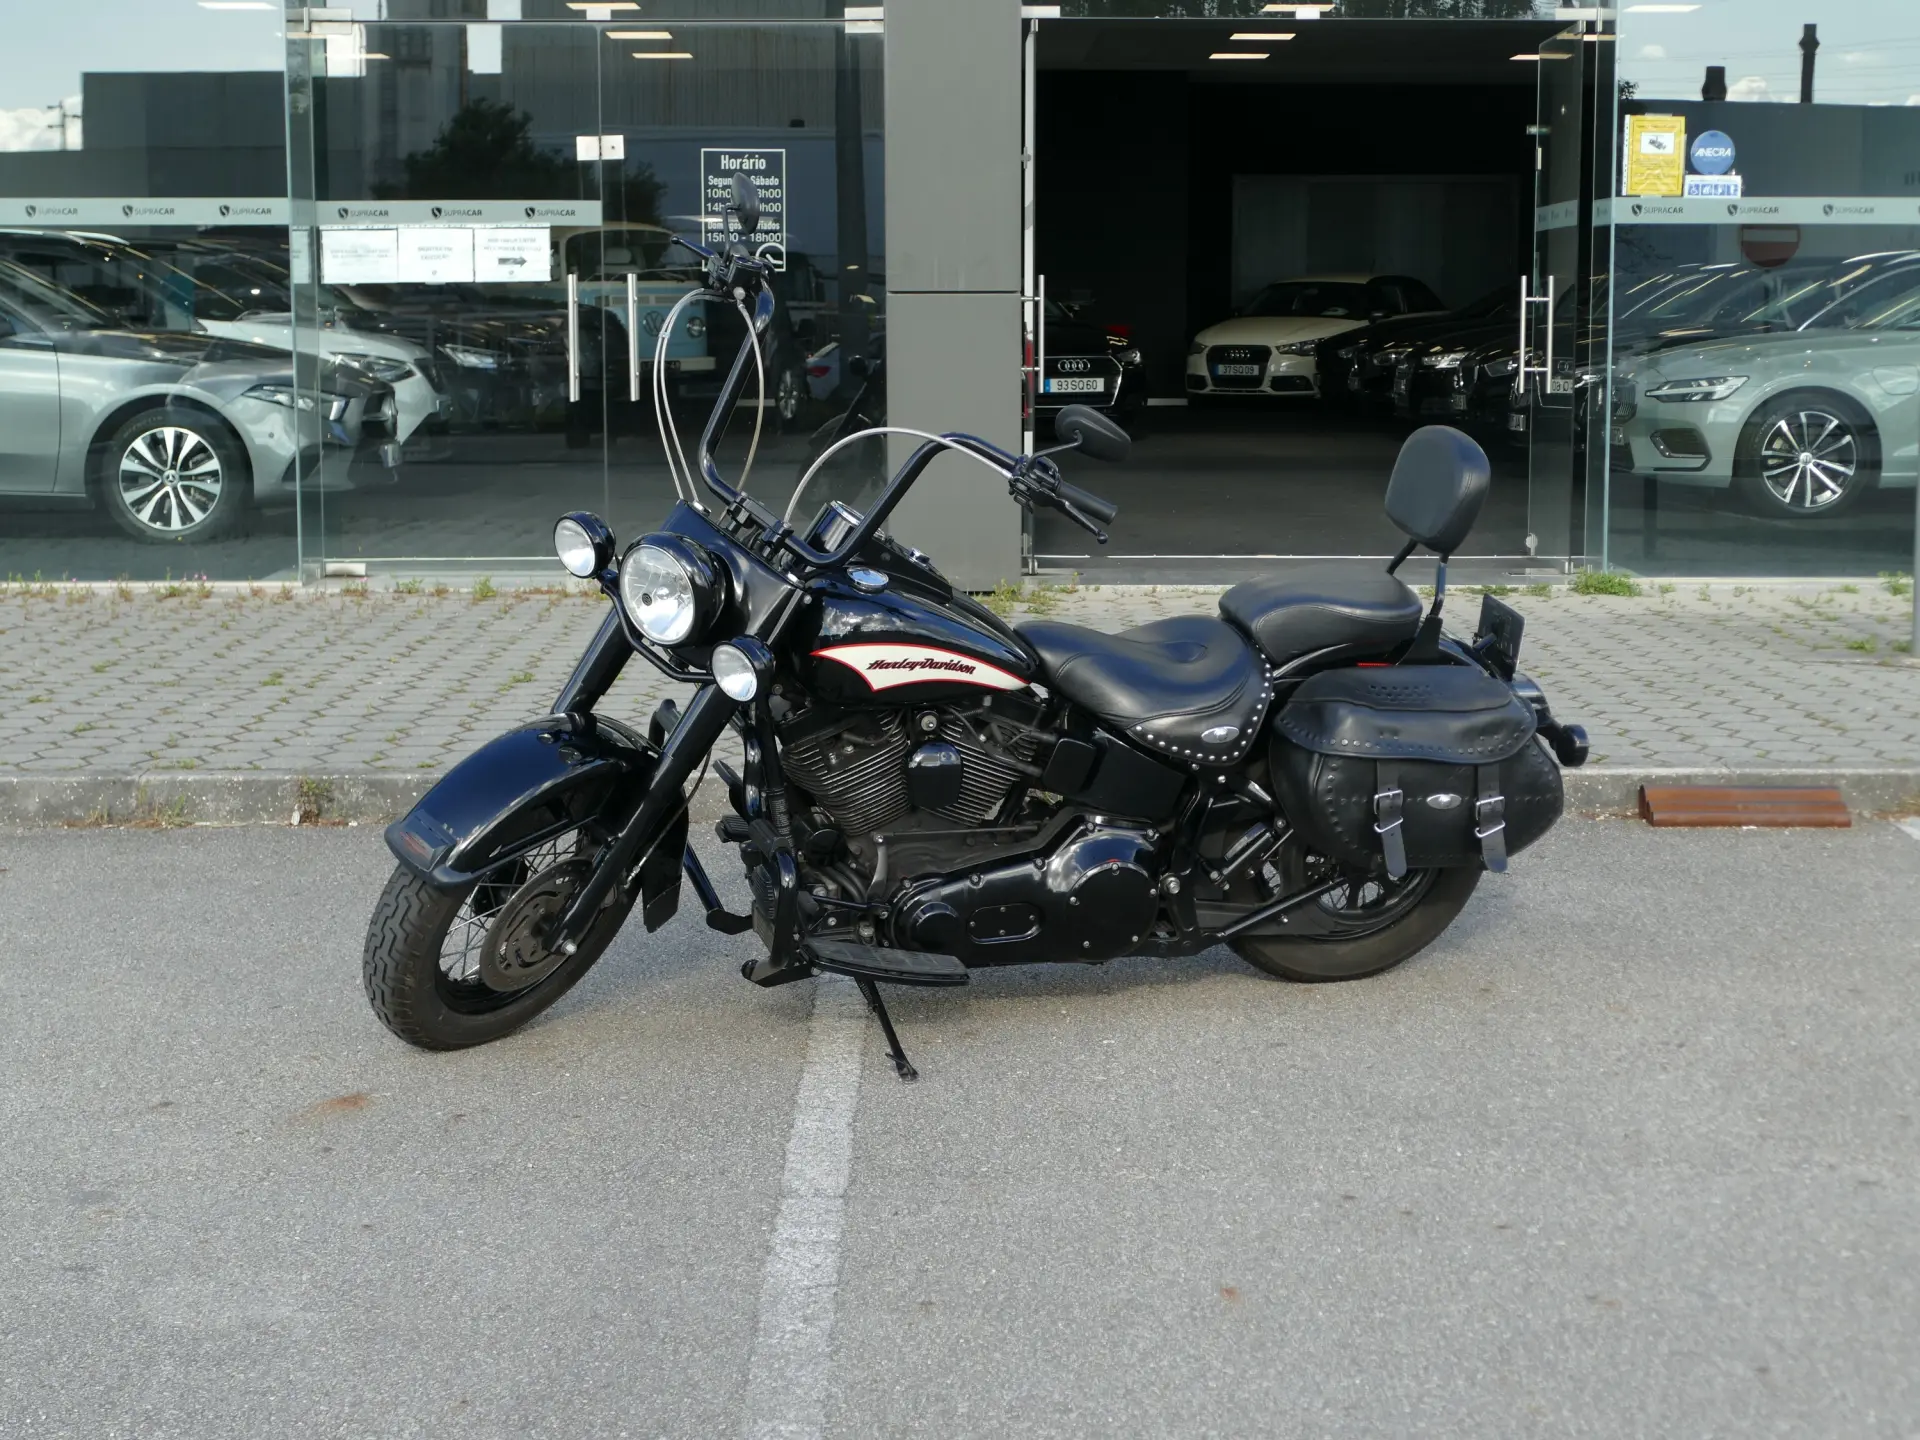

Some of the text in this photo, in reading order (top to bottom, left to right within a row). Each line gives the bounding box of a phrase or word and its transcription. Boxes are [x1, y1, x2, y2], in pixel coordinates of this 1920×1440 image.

[1694, 147, 1732, 157] ANECRA
[721, 154, 766, 170] Horário
[708, 175, 733, 187] Segun
[134, 207, 175, 215] SUPRACAR
[231, 207, 272, 215] SUPRACAR
[350, 209, 389, 217] SUPRACAR
[443, 209, 483, 217] SUPRACAR
[536, 209, 576, 217] SUPRACAR
[1643, 206, 1684, 214] SUPRACAR
[1739, 206, 1780, 214] SUPRACAR
[750, 232, 782, 242] 18h00
